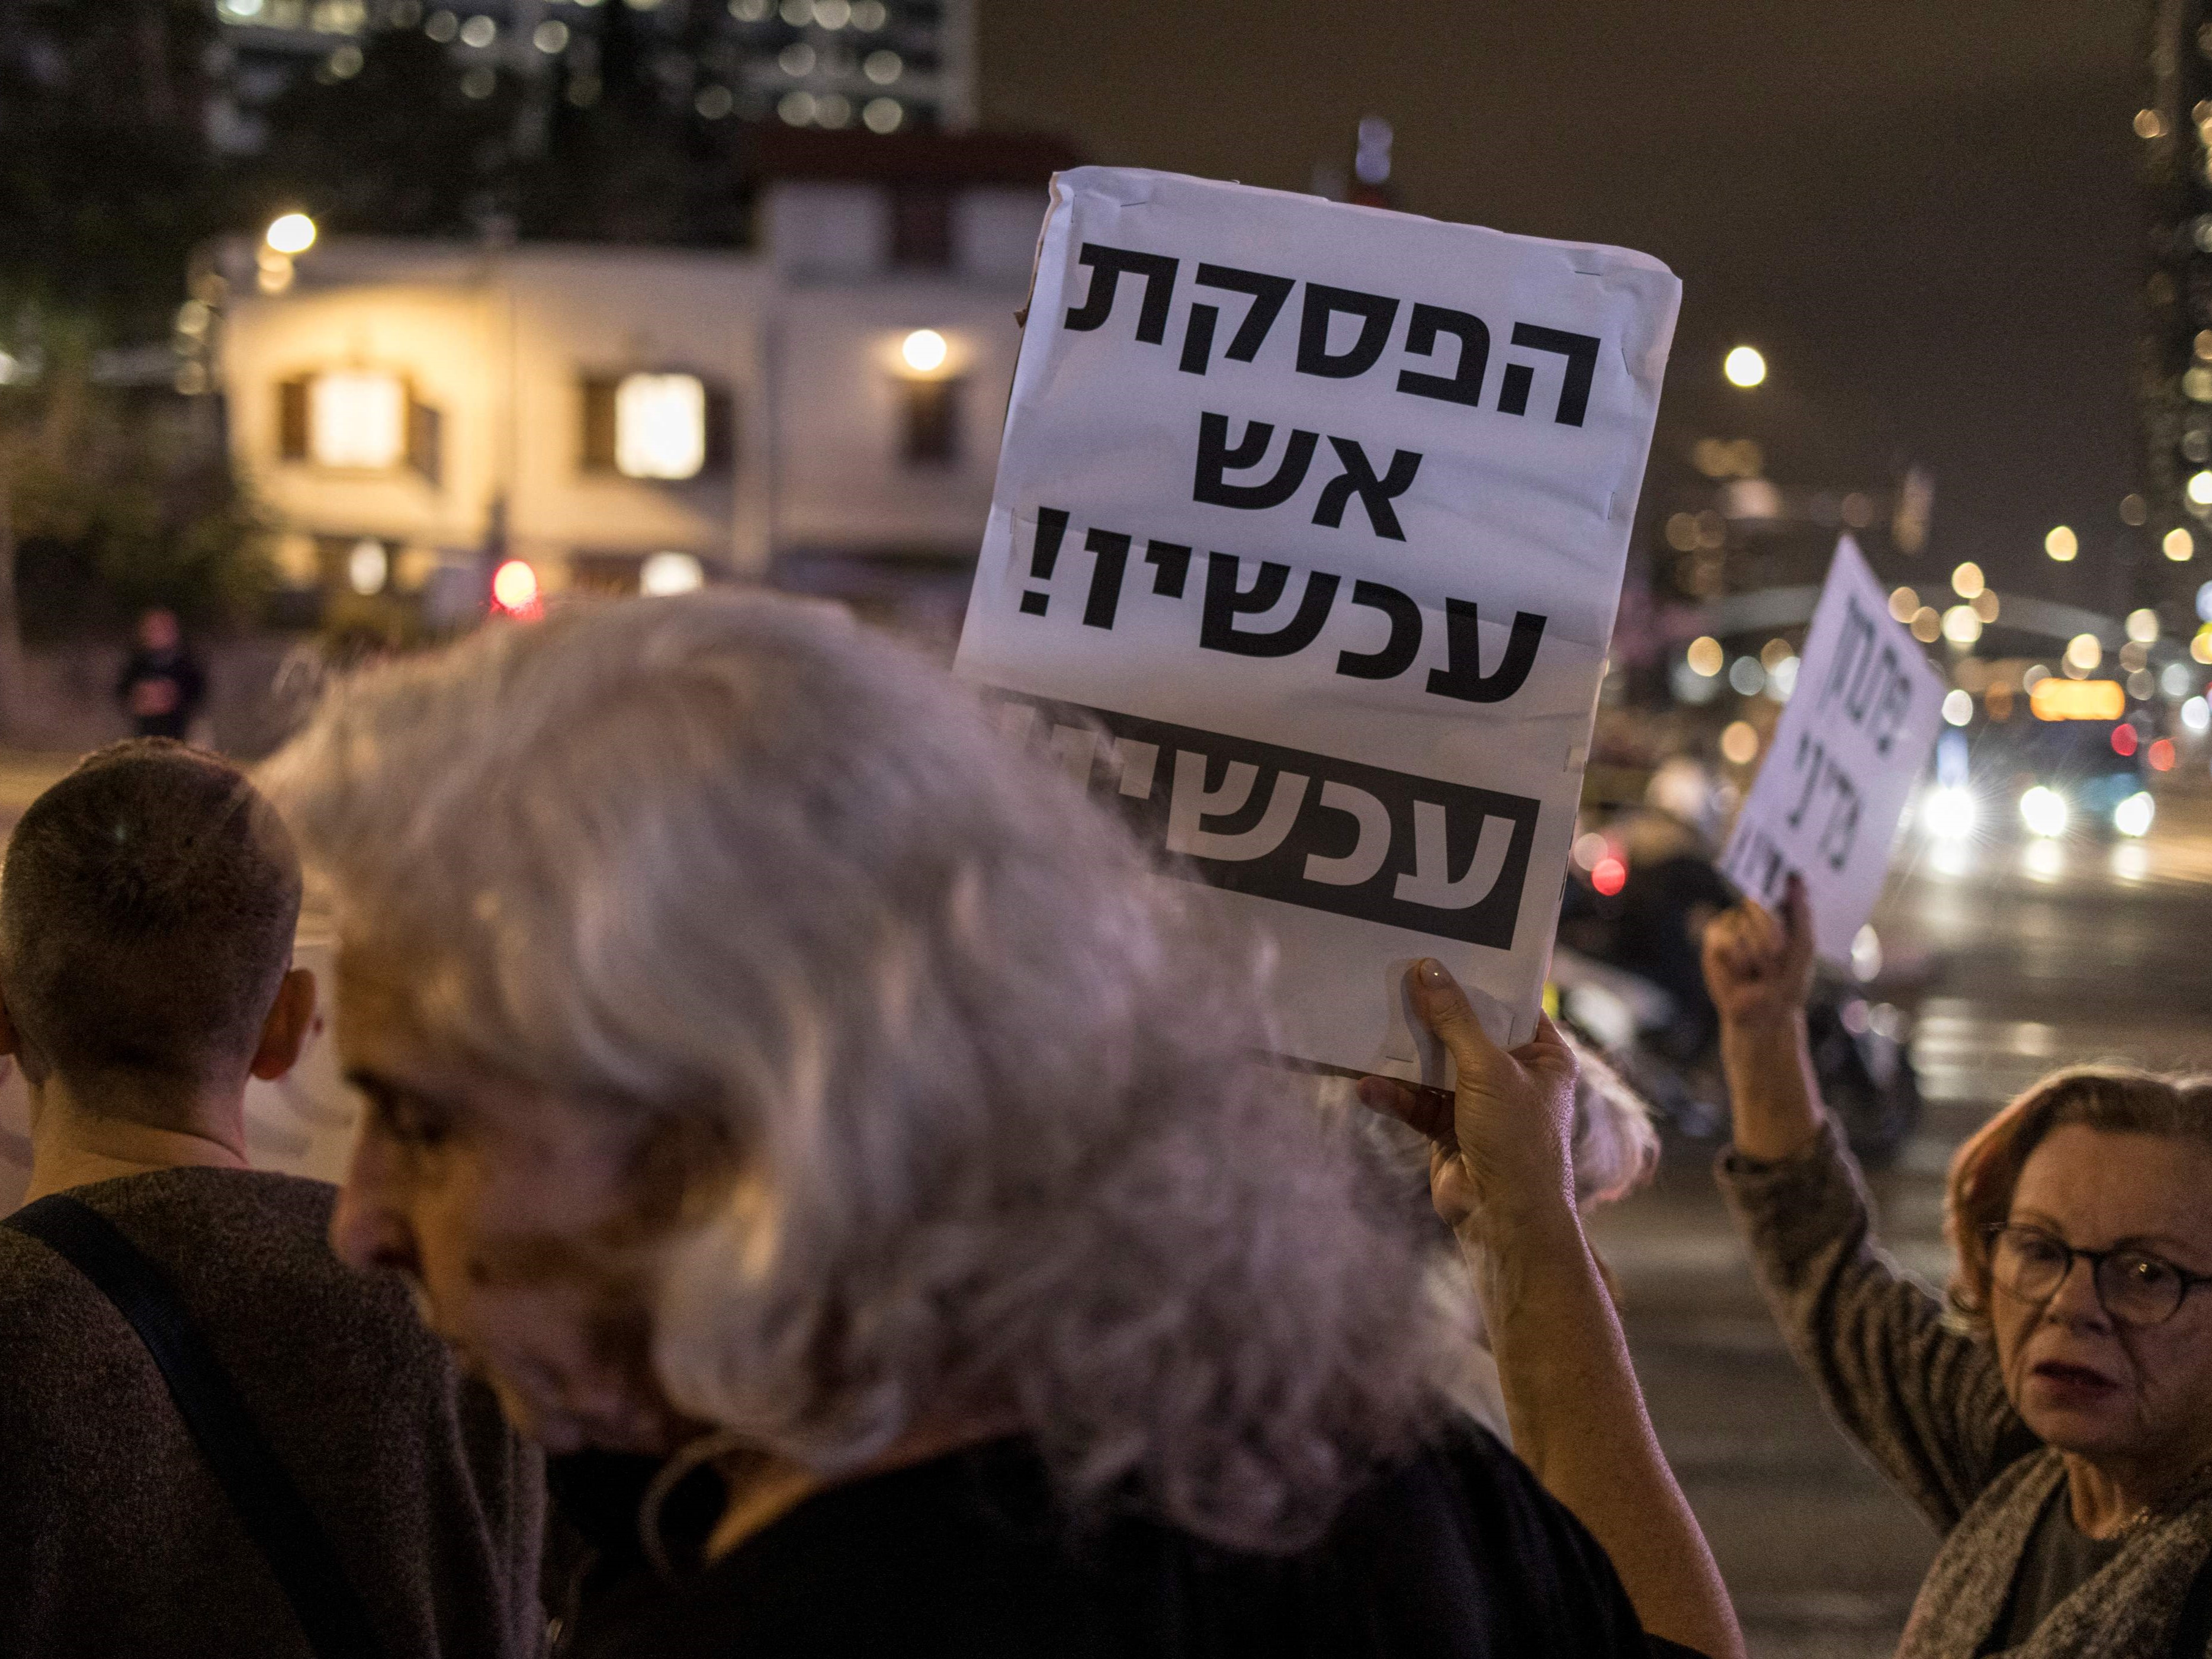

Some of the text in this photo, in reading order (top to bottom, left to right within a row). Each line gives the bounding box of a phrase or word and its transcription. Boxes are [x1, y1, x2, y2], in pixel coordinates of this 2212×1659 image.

[1064, 242, 1601, 427] הפסקת
[1192, 410, 1423, 542] אש
[1019, 506, 1548, 703] עכשיו!
